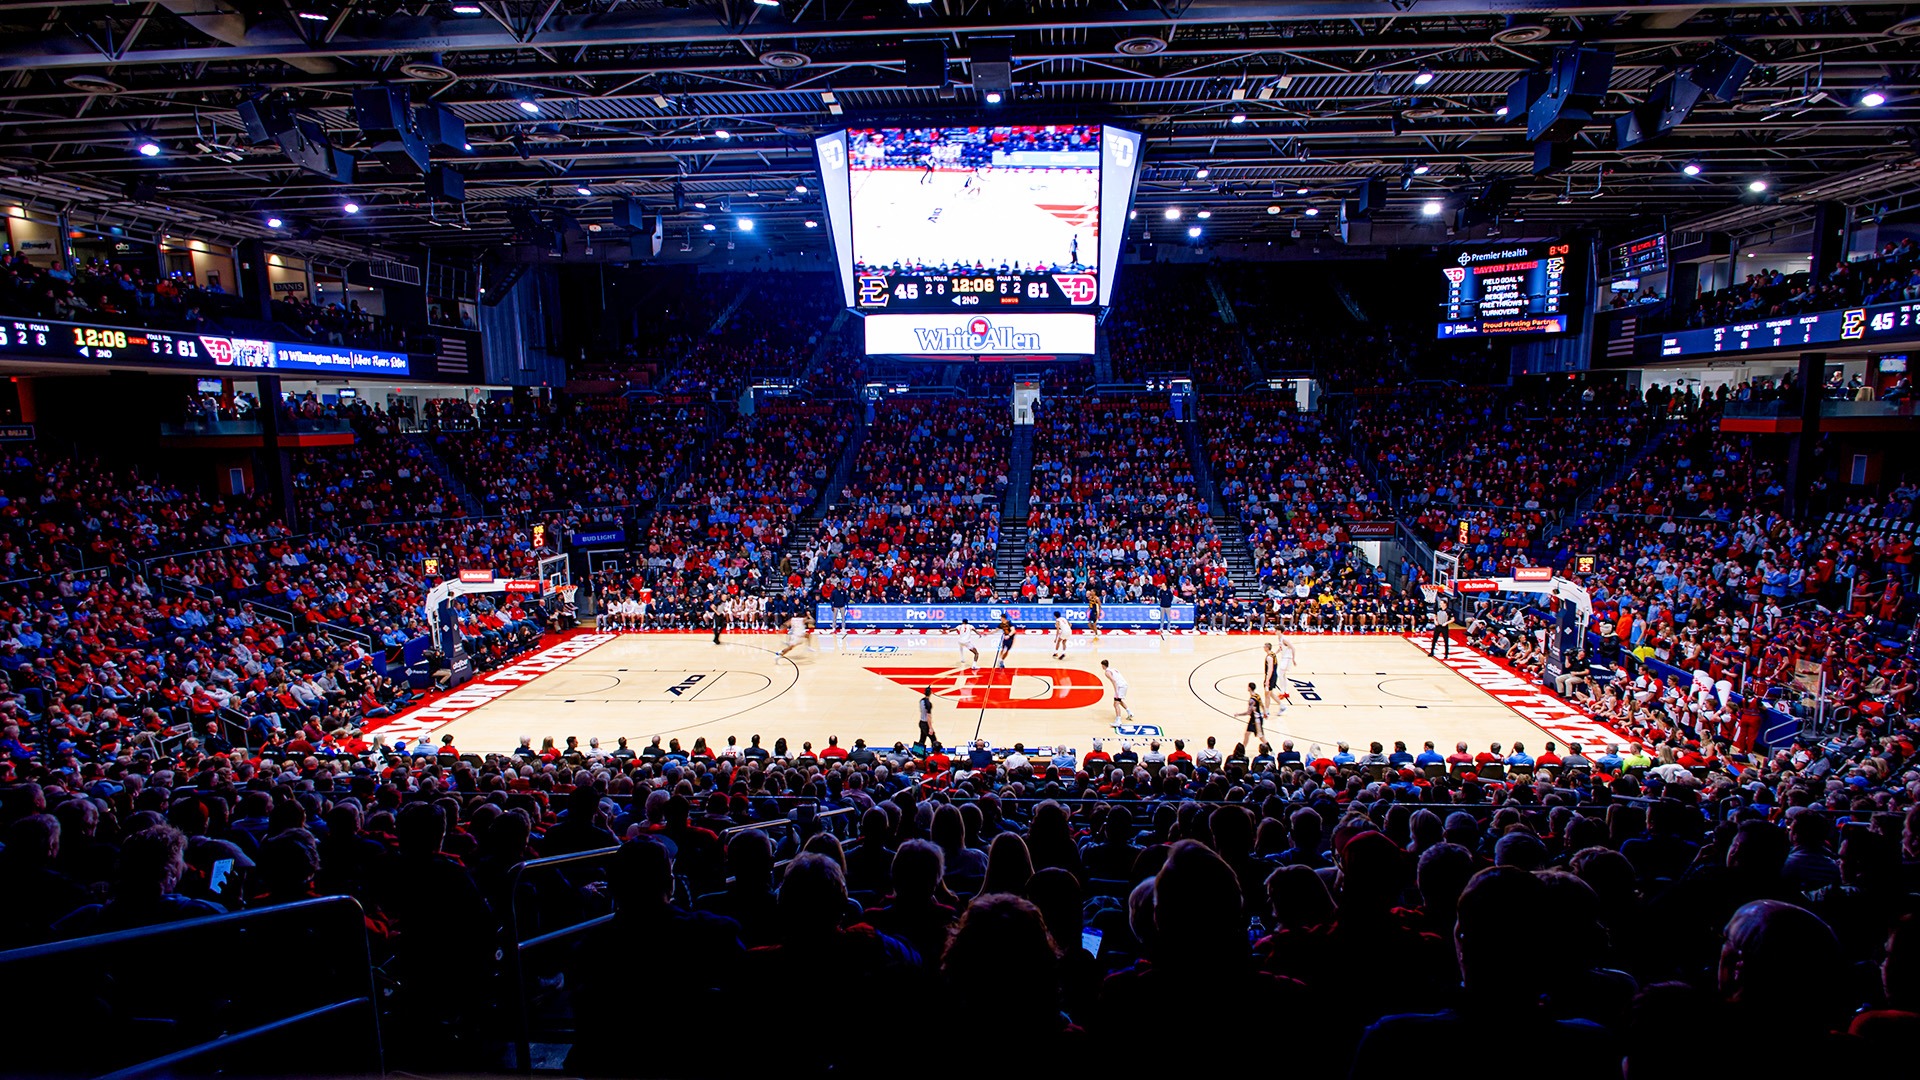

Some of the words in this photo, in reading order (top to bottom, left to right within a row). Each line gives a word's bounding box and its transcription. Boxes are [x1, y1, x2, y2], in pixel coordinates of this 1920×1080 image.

[1472, 251, 1500, 261] Premier
[1502, 247, 1527, 258] Health
[1549, 245, 1569, 256] 8:40
[1473, 264, 1505, 274] DAYTON
[1506, 261, 1538, 271] FLYERS
[894, 284, 919, 299] 45
[926, 284, 933, 295] 2
[937, 284, 945, 295] 8
[952, 278, 994, 293] 12:06
[1000, 283, 1008, 294] 5
[1013, 283, 1021, 294] 2
[962, 296, 979, 305] 2ND
[1504, 320, 1531, 328] Printing
[1870, 312, 1895, 331] 45
[1900, 314, 1910, 326] 2
[29, 323, 49, 332] FOULS
[18, 332, 28, 344] 2
[36, 333, 47, 346] 8
[73, 328, 127, 348] 12:06
[96, 350, 113, 358] 2ND
[152, 342, 160, 353] 5
[165, 343, 173, 354] 2
[178, 341, 198, 357] 61
[278, 350, 289, 360] 10
[288, 351, 332, 365] Wilmington
[332, 354, 350, 365] Place
[1349, 525, 1390, 533] Budweiser
[596, 533, 617, 541] LIGHT
[906, 609, 945, 620] ProUD
[484, 633, 618, 683] FLYERS
